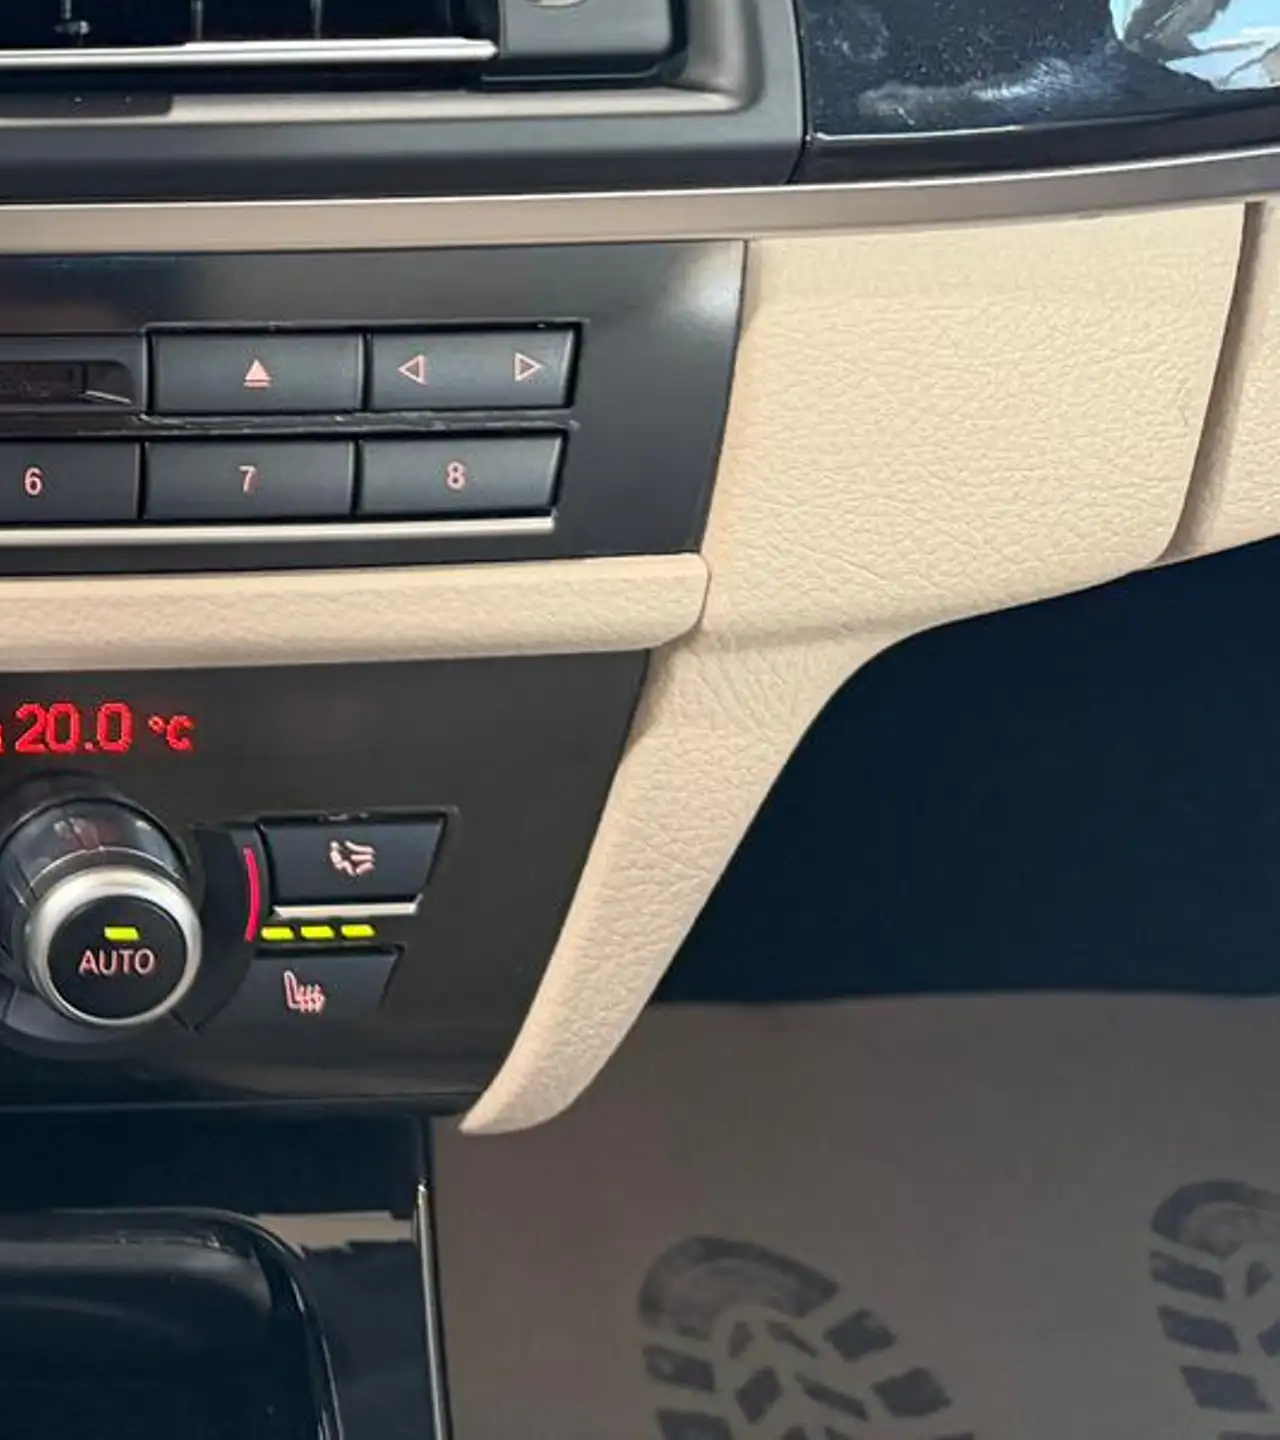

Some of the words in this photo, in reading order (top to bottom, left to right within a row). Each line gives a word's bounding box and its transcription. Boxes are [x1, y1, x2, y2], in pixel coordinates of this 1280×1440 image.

[23, 467, 43, 497] 6
[239, 465, 257, 494] 7
[445, 462, 466, 492] 8
[14, 701, 134, 754] 20.0
[77, 948, 157, 977] AUTO
